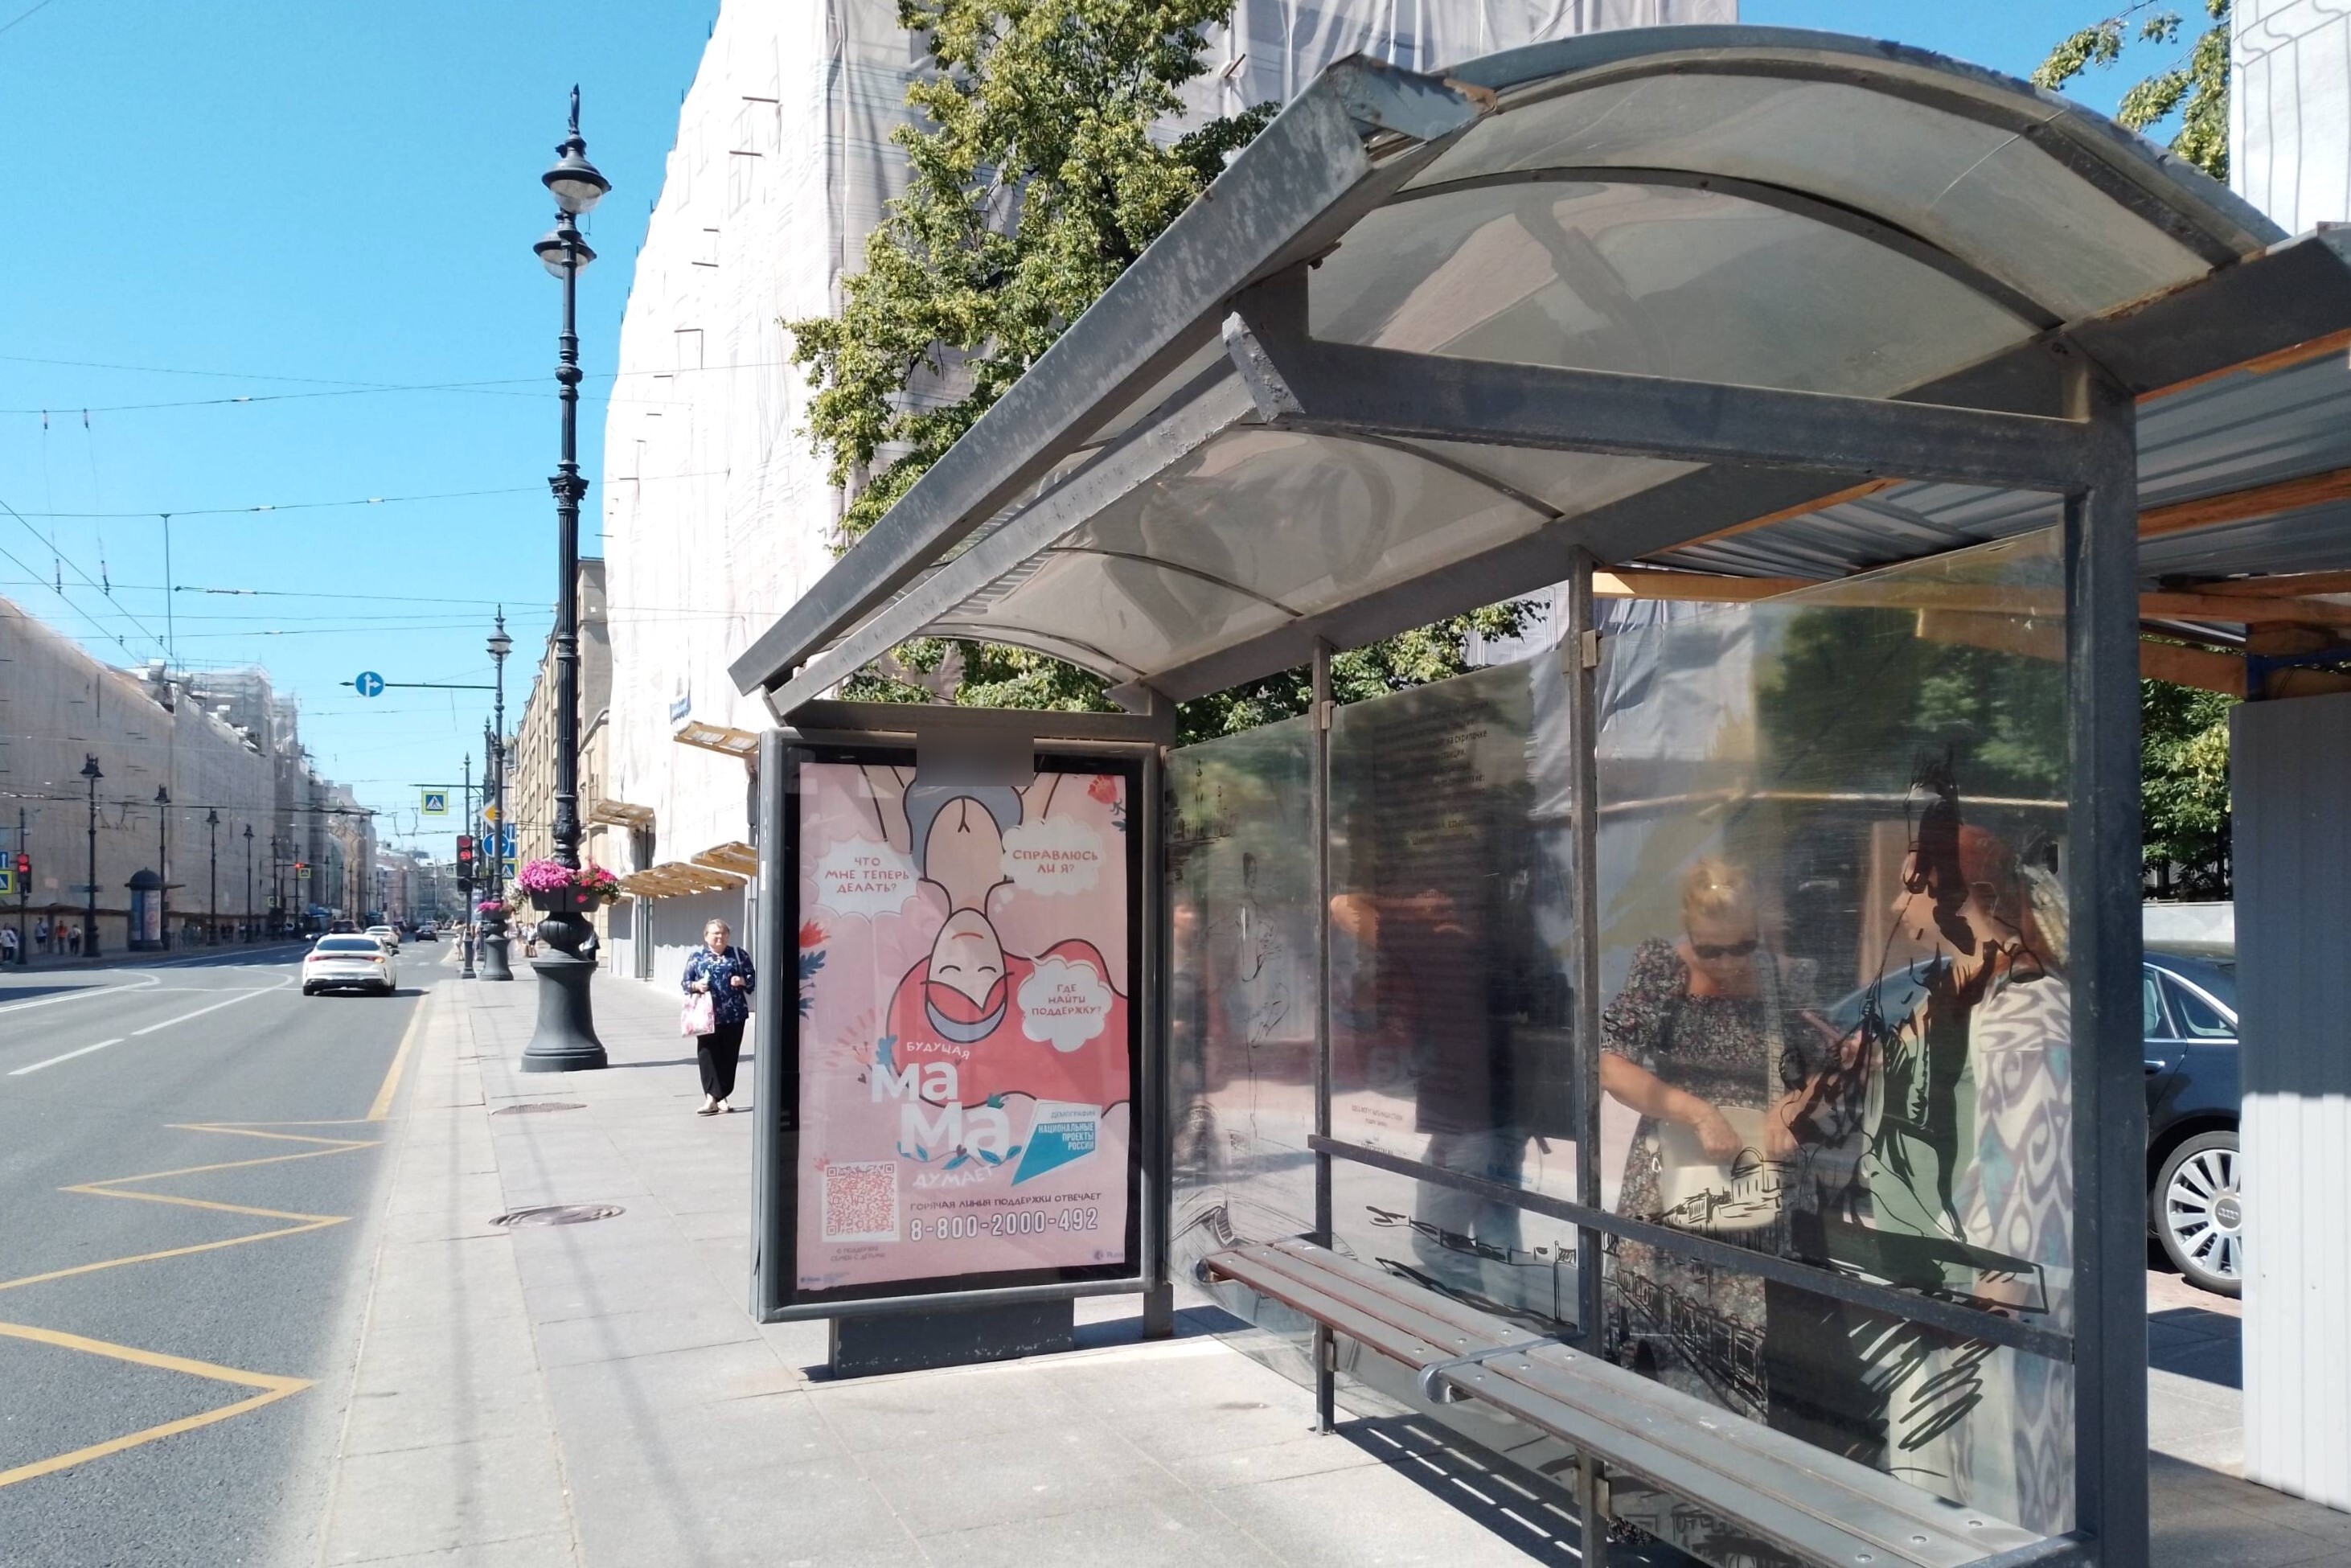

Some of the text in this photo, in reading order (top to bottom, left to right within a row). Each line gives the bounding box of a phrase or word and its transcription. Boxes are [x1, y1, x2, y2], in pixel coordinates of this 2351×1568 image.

[1012, 849, 1098, 861] СПРАВЛЮСЬ
[855, 857, 881, 866] ЧТО
[1037, 863, 1075, 873] ЛИ Я?
[825, 870, 910, 880] МНЕ ТЕПЕРЬ
[836, 883, 896, 893] ДЕЛАТЬ?
[1057, 983, 1076, 993] ГДЕ
[1048, 993, 1085, 1004] НАЙТИ
[1032, 1006, 1102, 1016] ПОДДЕРЖКУ?
[906, 1042, 970, 1060] БУДУЩАЯ
[1038, 1123, 1093, 1133] НАЦИОНАЛЬНЫЕ
[1062, 1133, 1093, 1141] ПРОЕКТЫ
[1068, 1141, 1093, 1150] РОССИИ
[913, 1166, 995, 1188] ДУМАЕТ
[910, 1192, 1102, 1211] ГОРЯЧАЯ ЛИНИЯ ПОДДЕРЖКИ ОТВЕЧАЕТ
[909, 1207, 1098, 1242] 8-800-2000-492
